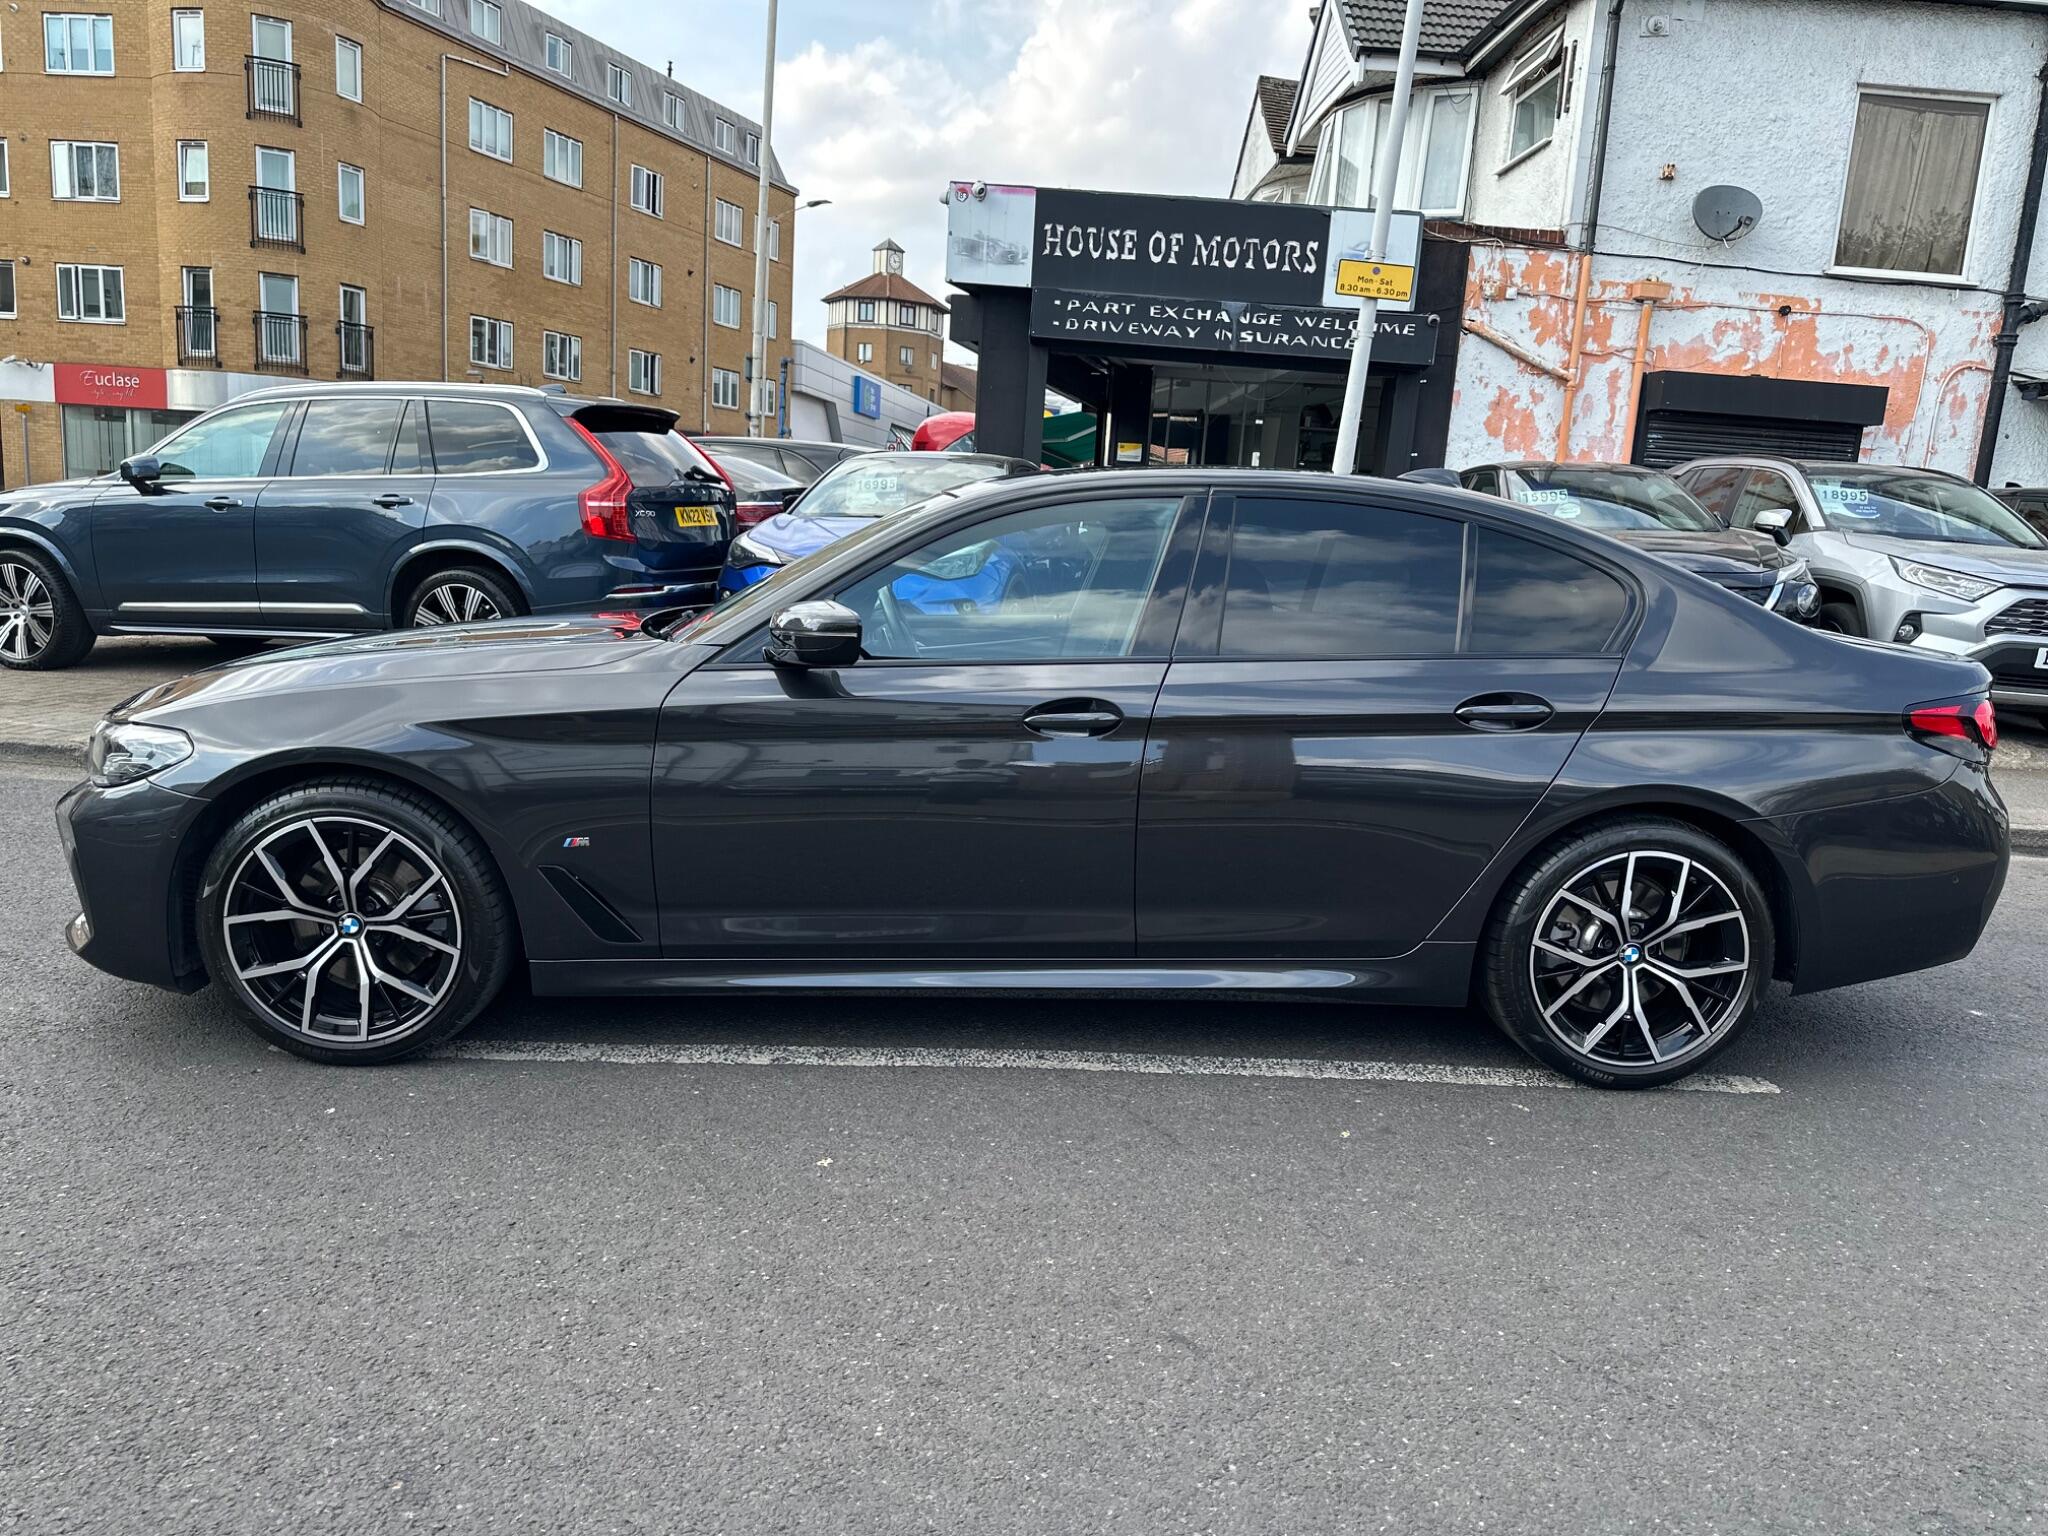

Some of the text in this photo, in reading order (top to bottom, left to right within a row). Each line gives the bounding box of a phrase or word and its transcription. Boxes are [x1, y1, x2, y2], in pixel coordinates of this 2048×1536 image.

[1042, 223, 1319, 273] HOUSE OF MOTORS
[1357, 275, 1374, 284] Mon
[1379, 278, 1393, 286] Sat
[1376, 287, 1395, 296] 6.30
[1067, 300, 1416, 336] PART EXCHANGE WELCME
[1065, 318, 1201, 338] DRIVEWAY
[80, 370, 140, 388] Euclase
[1823, 489, 1867, 502] 18995
[634, 510, 656, 518] XC90
